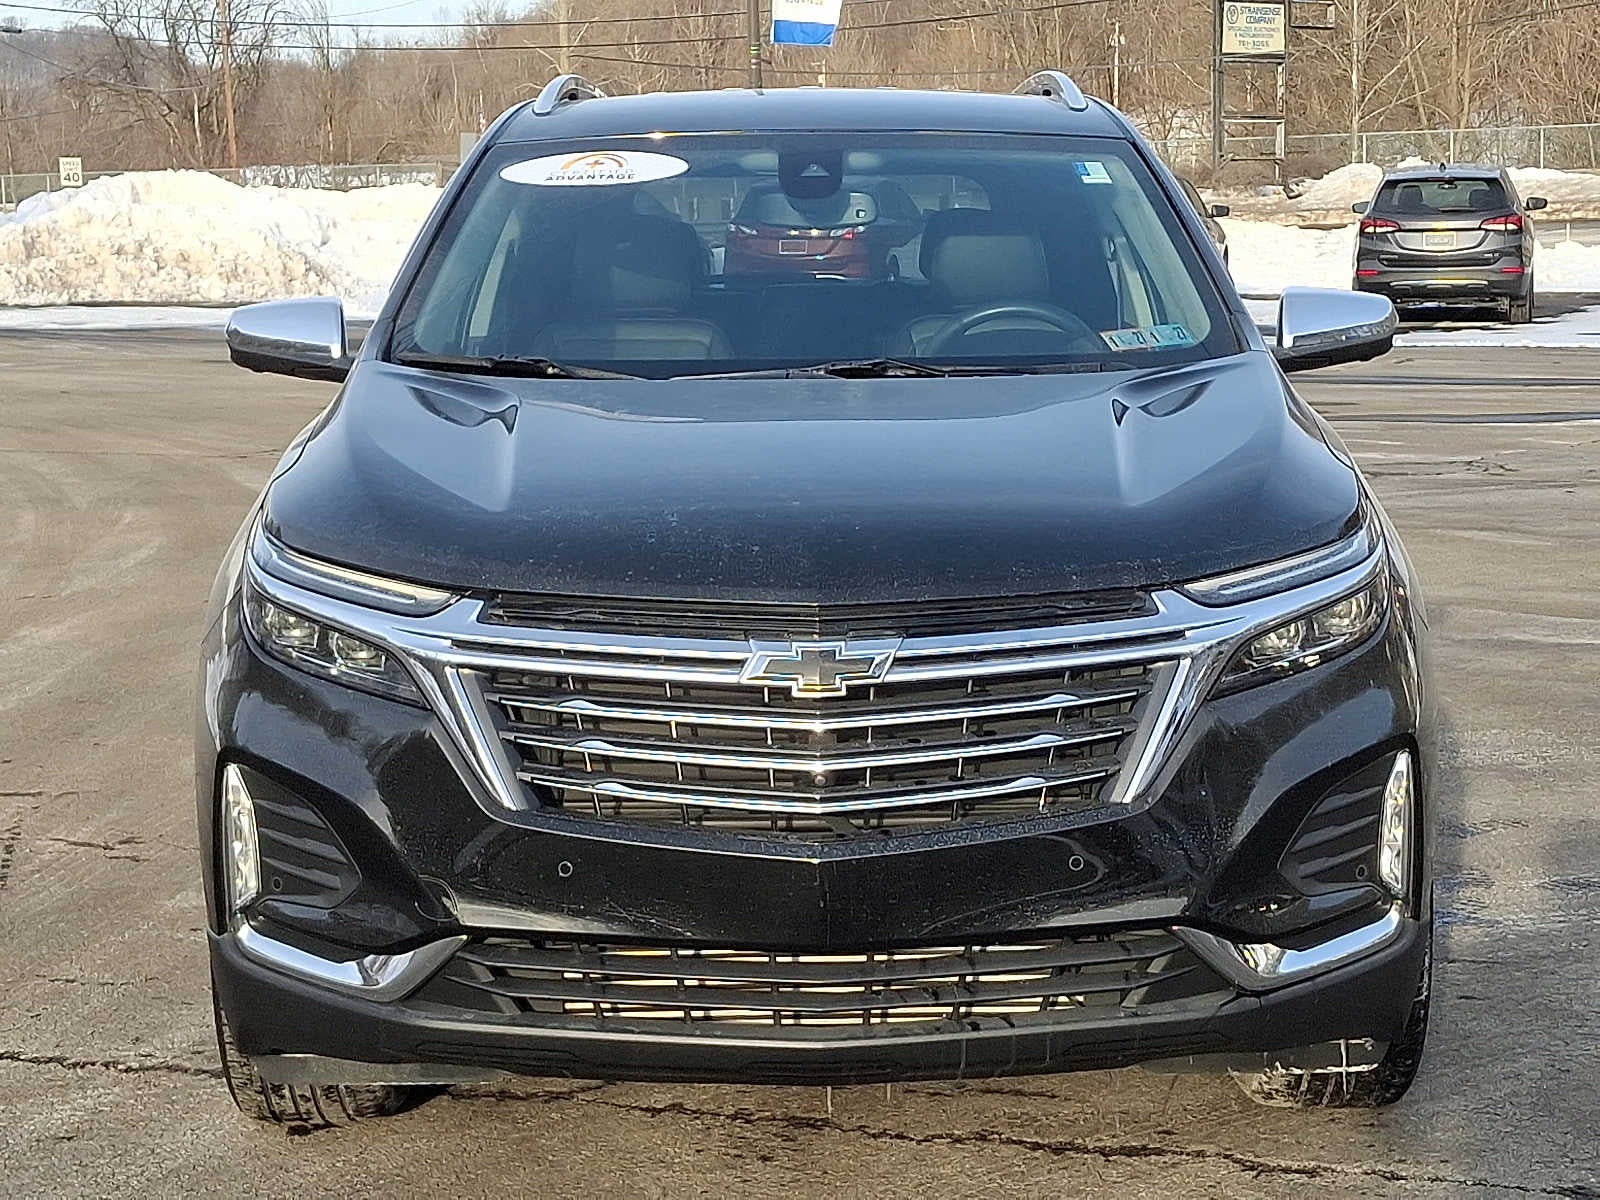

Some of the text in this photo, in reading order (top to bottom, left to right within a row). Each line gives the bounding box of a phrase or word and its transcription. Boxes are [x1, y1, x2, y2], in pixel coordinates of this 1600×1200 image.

[1246, 15, 1275, 24] COMPANY
[64, 172, 80, 182] 40
[544, 173, 636, 181] ADVANTAGE
